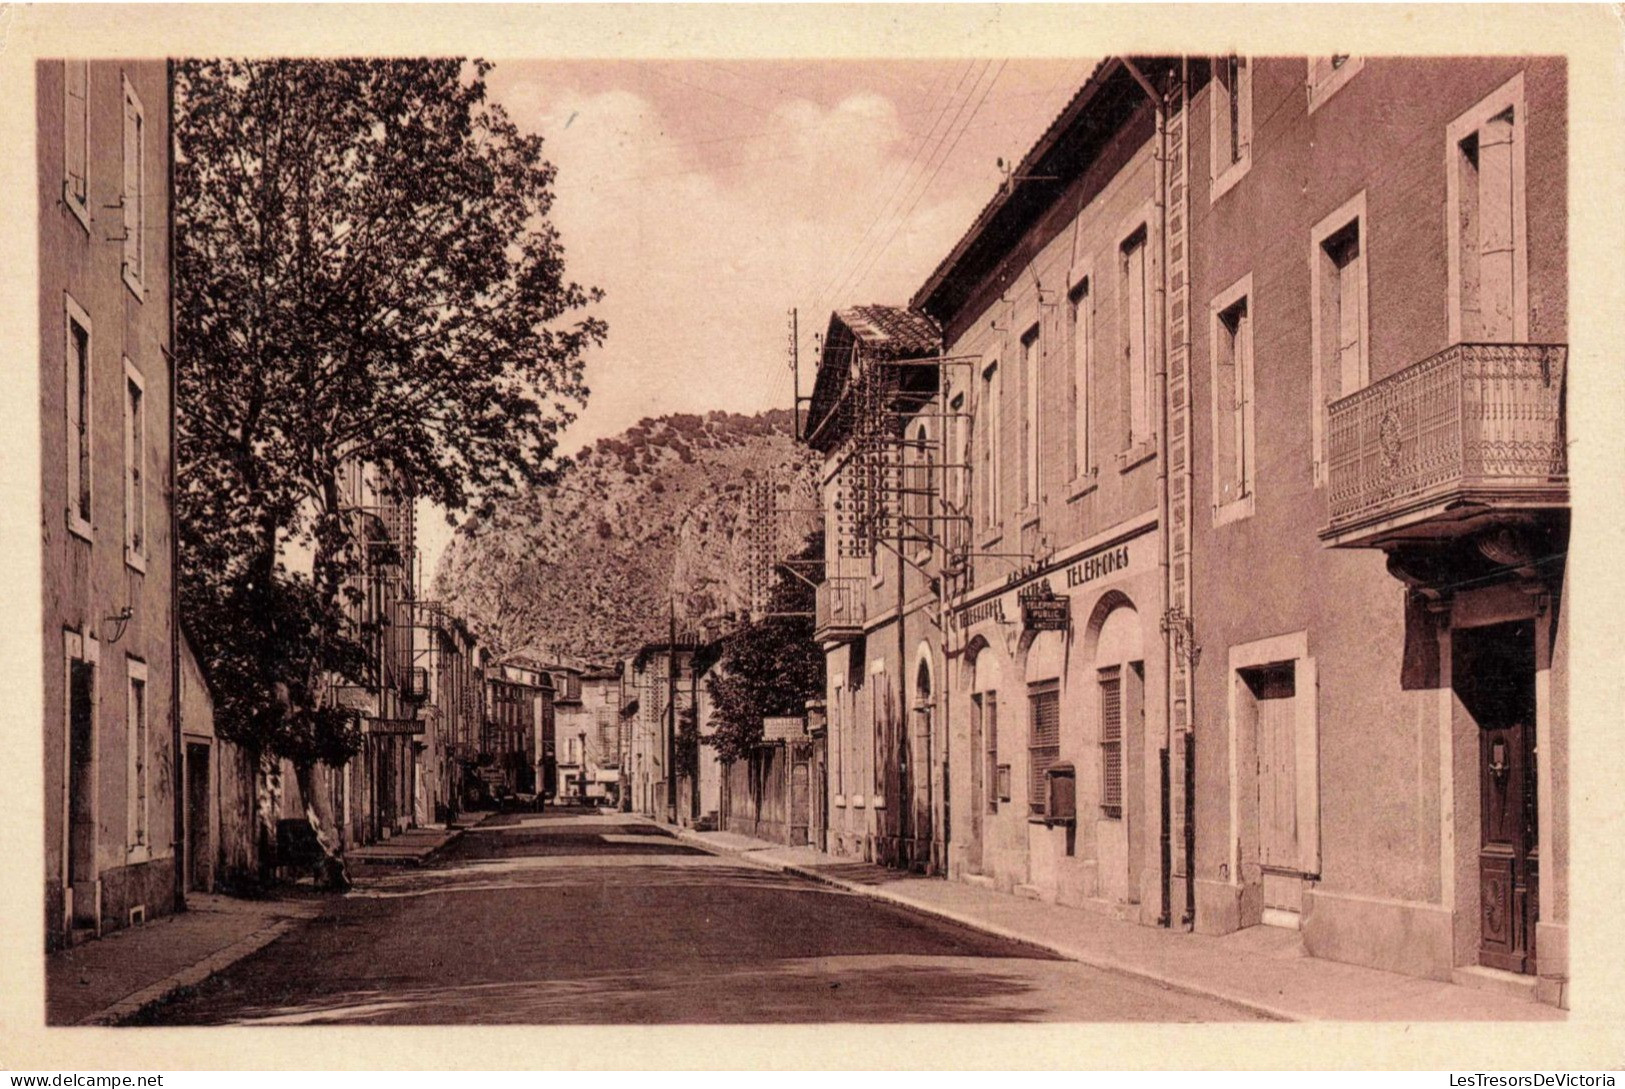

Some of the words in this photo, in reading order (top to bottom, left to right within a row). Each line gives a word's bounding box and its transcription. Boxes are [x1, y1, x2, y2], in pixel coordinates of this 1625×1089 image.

[1066, 546, 1129, 588] TELEPHONES
[1026, 601, 1066, 610] TELEPHONE
[1033, 610, 1060, 618] PUBLIC
